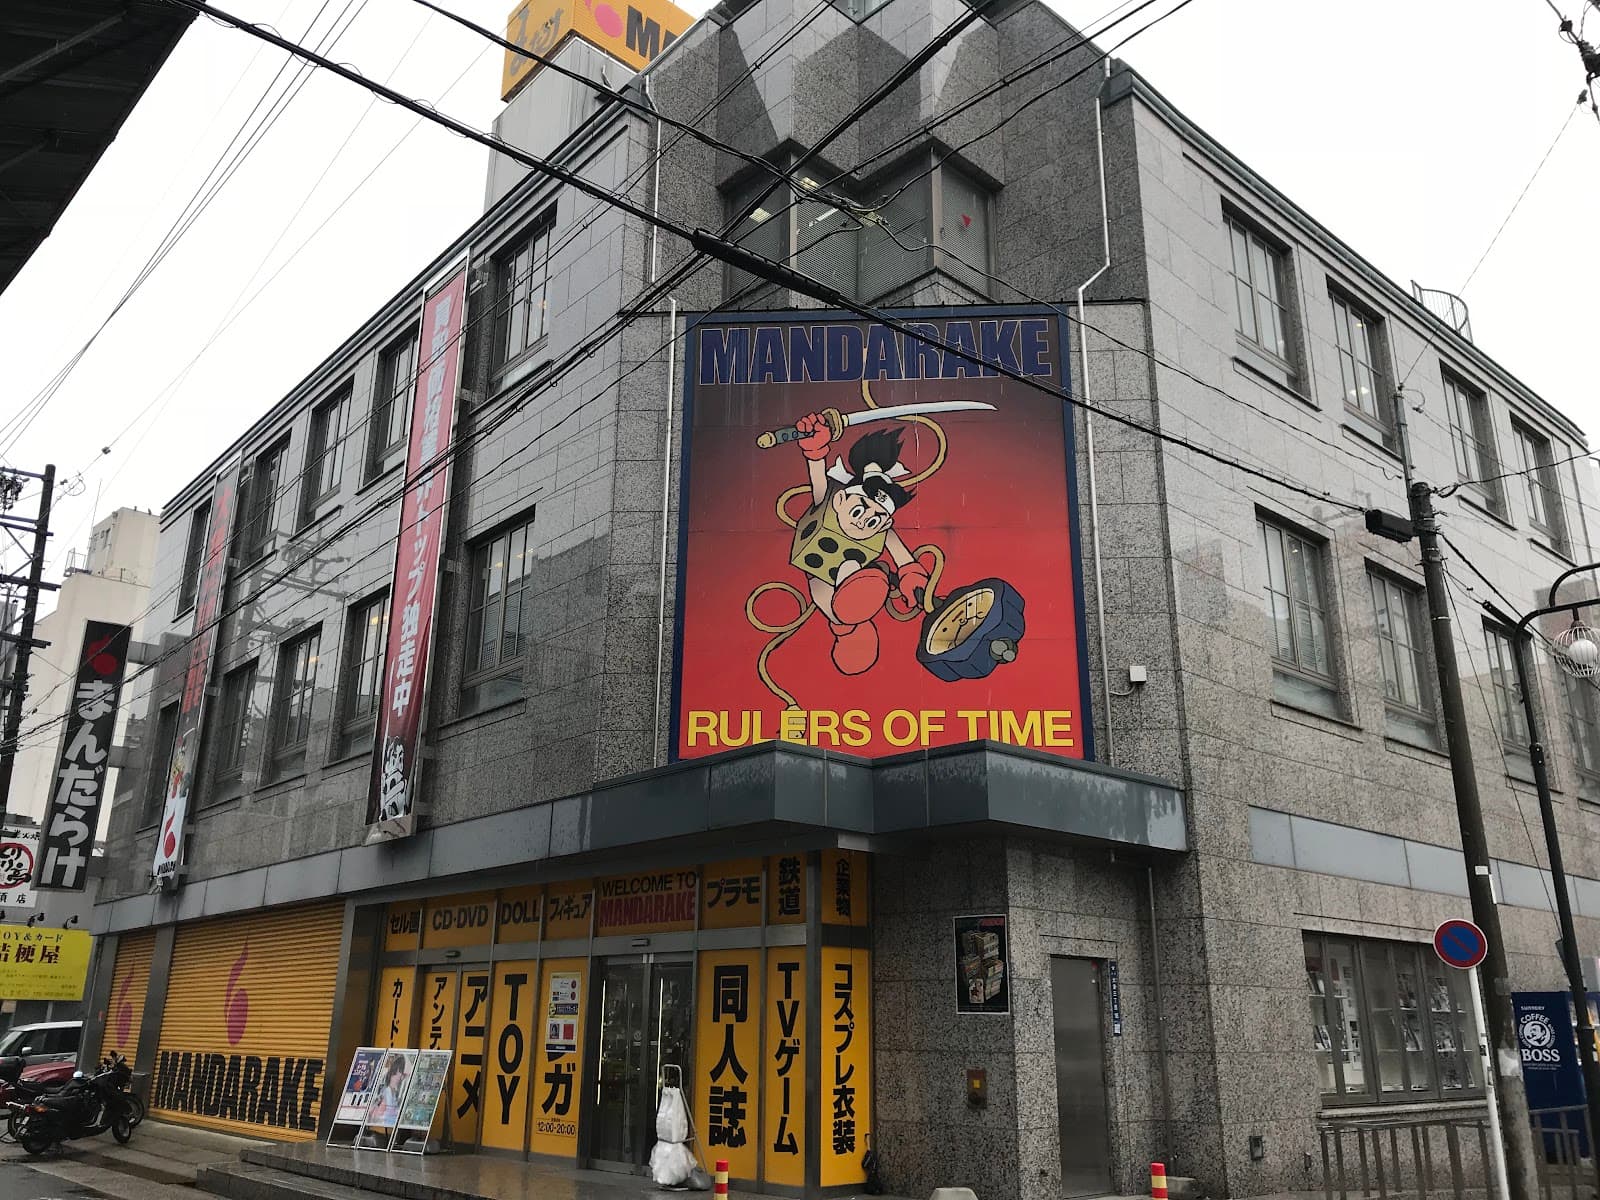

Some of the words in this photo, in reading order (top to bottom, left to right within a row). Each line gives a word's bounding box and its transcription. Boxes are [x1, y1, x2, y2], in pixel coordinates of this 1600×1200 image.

[700, 319, 1053, 385] MANDARAKE
[687, 710, 871, 747] RULERS
[883, 710, 944, 746] OF
[957, 710, 1073, 747] TIME
[41, 680, 115, 888] まんだらけ
[502, 900, 539, 925] DOLL
[550, 893, 592, 921] フィギュア
[600, 890, 695, 928] MANDARAKE
[602, 874, 672, 896] WELCOME
[676, 871, 696, 890] TO
[707, 877, 761, 908] プラモ
[778, 857, 800, 916] 鉄道
[430, 977, 448, 1050] アンテ
[1520, 1013, 1550, 1024] COFFEE
[457, 976, 488, 1119] アニメ
[497, 974, 527, 1124] TOY
[709, 965, 748, 1147] 同人誌
[774, 963, 800, 1155] TVゲーム
[833, 964, 855, 1155] コスプレ衣装
[1521, 1048, 1561, 1062] BOSS
[153, 1052, 323, 1130] MANDARAKE
